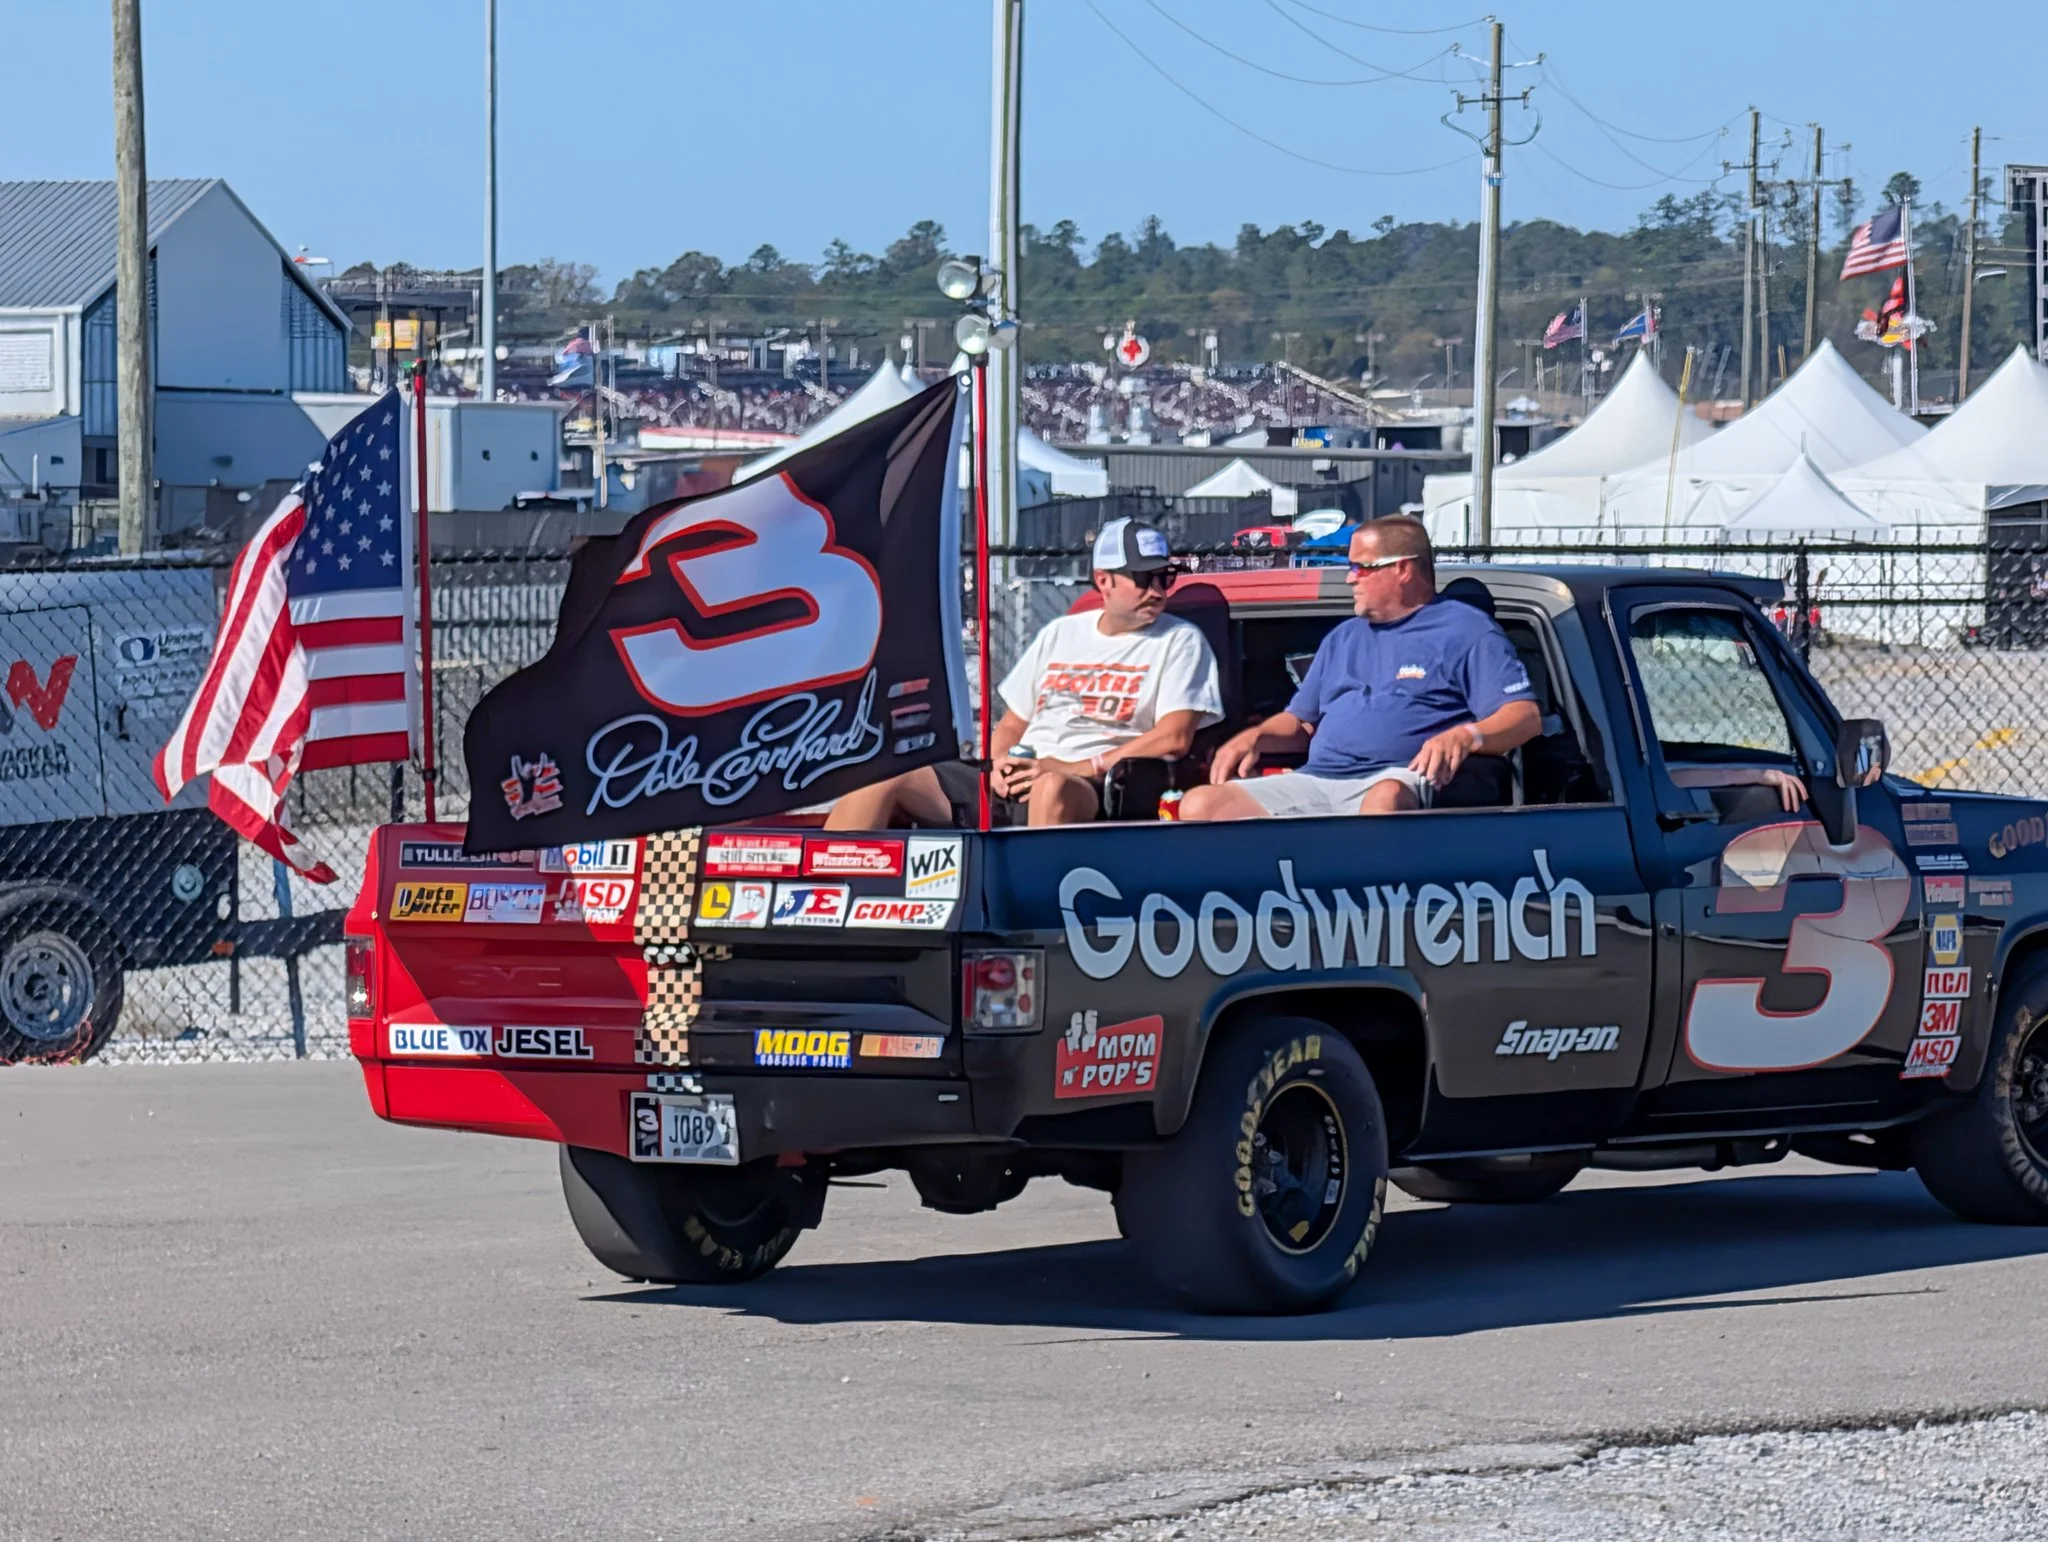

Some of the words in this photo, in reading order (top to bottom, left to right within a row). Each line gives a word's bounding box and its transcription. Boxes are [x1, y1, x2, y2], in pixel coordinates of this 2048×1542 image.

[608, 471, 883, 718] 3
[1988, 816, 2048, 859] GOOD
[911, 845, 956, 878] WIX
[409, 901, 461, 914] Meter
[415, 887, 455, 901] Auto
[854, 903, 925, 921] COMP
[1058, 849, 1597, 980] Goodwrench
[1684, 820, 1912, 1074] 3
[1922, 1002, 1958, 1033] 3M
[395, 1029, 449, 1051] BLUE
[458, 1029, 488, 1051] OX
[498, 1028, 593, 1056] JESEL
[756, 1029, 850, 1055] MOOG
[1097, 1033, 1156, 1060] MOM
[1495, 1020, 1620, 1061] Snap-on
[1910, 1039, 1955, 1065] MSD
[1081, 1060, 1153, 1088] POP'S
